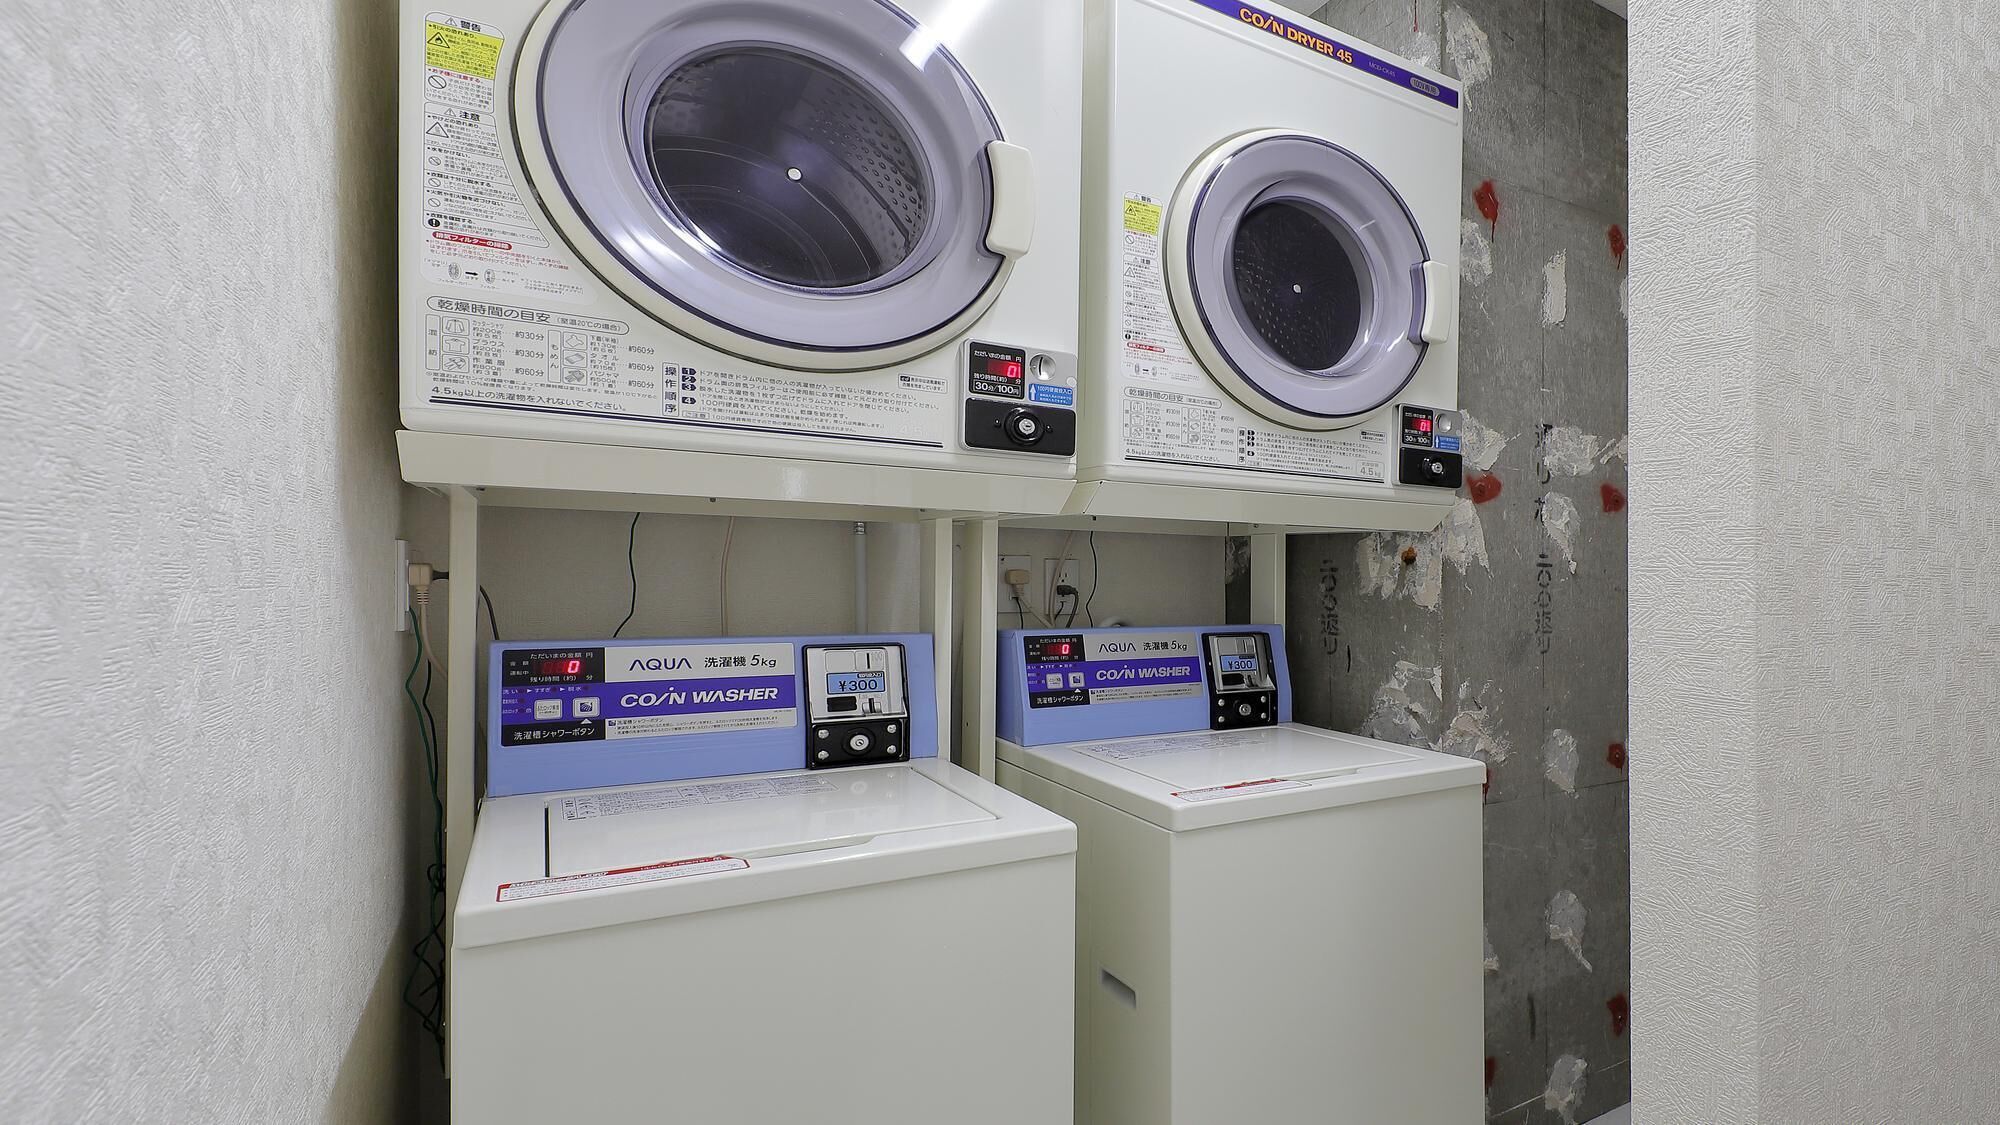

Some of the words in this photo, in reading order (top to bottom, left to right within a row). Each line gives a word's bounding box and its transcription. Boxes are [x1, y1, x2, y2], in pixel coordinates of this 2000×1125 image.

[461, 20, 481, 32] 警告
[1287, 26, 1334, 56] DRYER
[1336, 48, 1353, 64] 45
[460, 112, 480, 121] 注意
[438, 299, 550, 323] 乾燥時間の目安
[473, 339, 504, 347] ブラウス
[664, 366, 676, 414] 操作順序
[432, 386, 626, 412] 4.5kg以上の洗濯物を入れないでください。
[1062, 644, 1070, 654] 0
[1099, 642, 1136, 652] AQUA
[1143, 641, 1168, 650] 洗濯機
[1171, 640, 1188, 651] 5kg
[568, 660, 580, 674] 0
[629, 658, 692, 671] AQUA
[704, 656, 746, 668] 洗濯機
[750, 654, 776, 668] 5kg
[1228, 660, 1252, 670] ¥300
[1138, 666, 1190, 678] WASHER
[838, 680, 877, 692] ¥300
[692, 688, 778, 704] WASHER
[514, 728, 594, 740] 洗濯槽シャワーボタン
